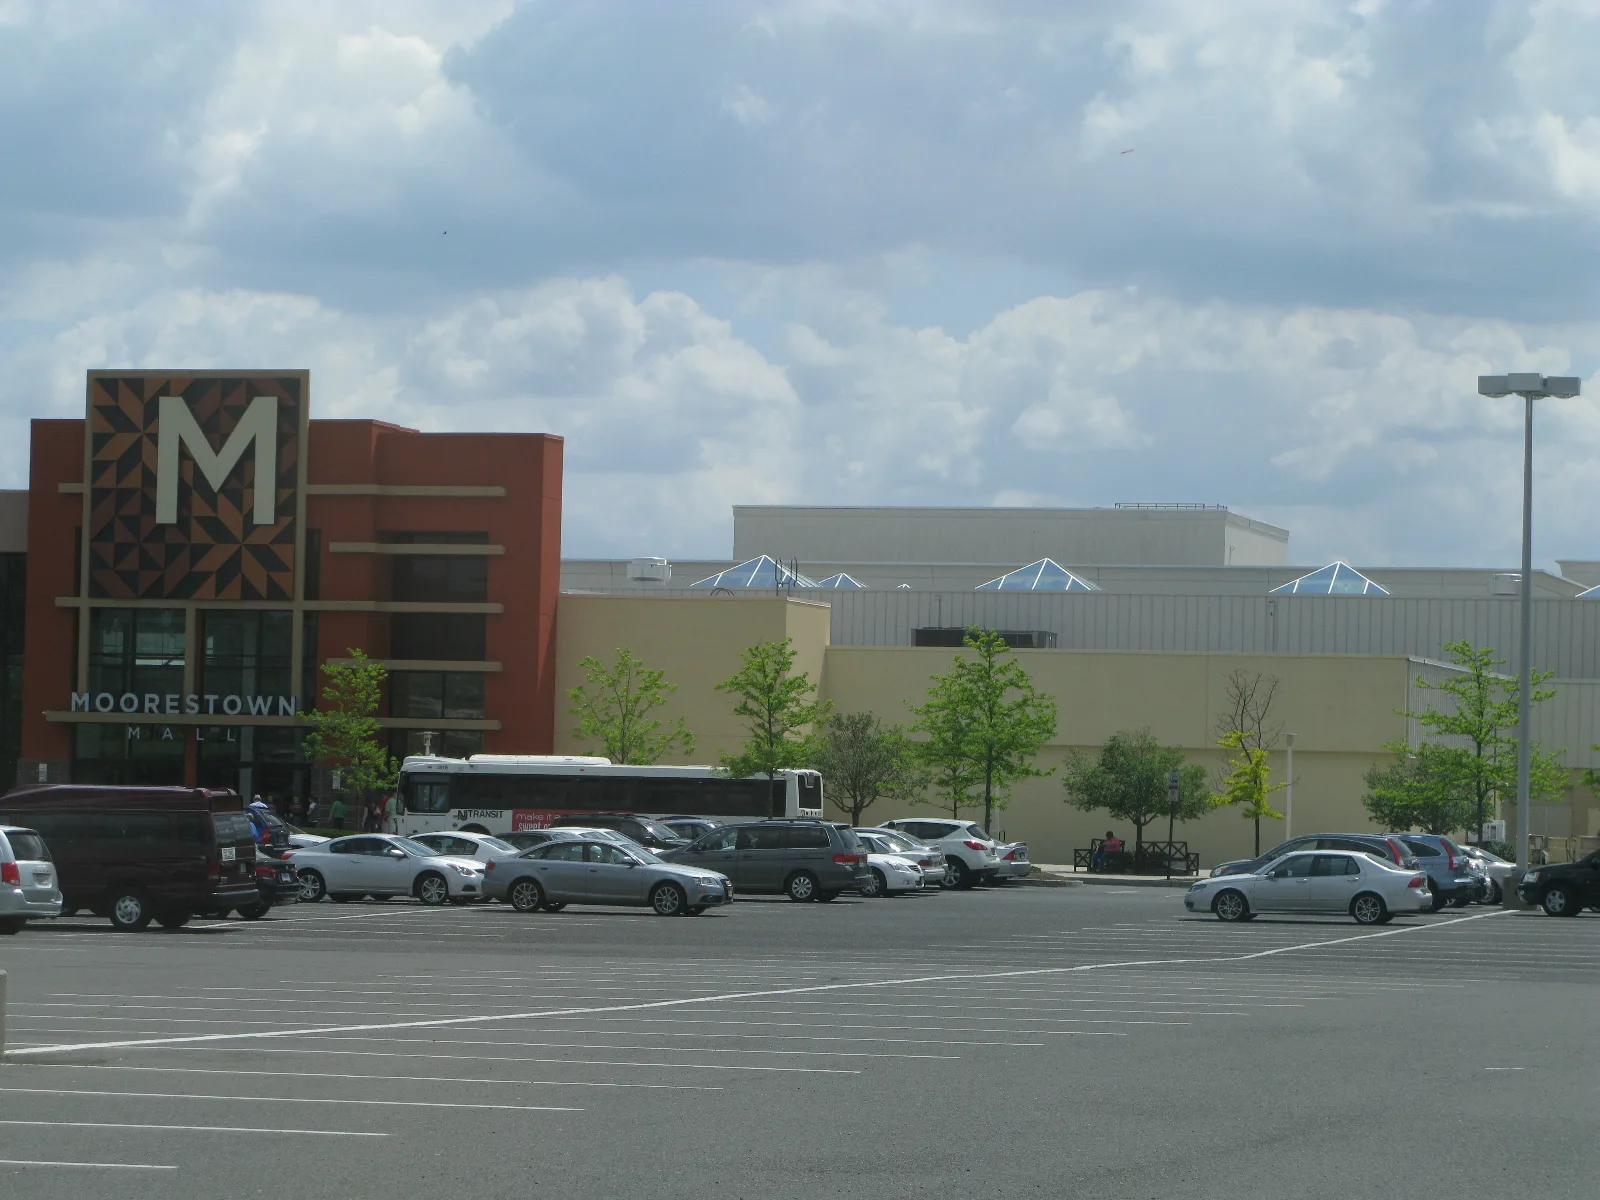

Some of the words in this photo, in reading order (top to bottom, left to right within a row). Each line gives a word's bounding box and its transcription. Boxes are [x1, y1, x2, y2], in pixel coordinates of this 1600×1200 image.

[155, 396, 278, 525] M
[71, 691, 297, 716] MOORESTOWN
[128, 726, 236, 742] MALL
[468, 809, 504, 819] TRANSIT
[515, 812, 544, 821] make
[546, 812, 553, 821] it
